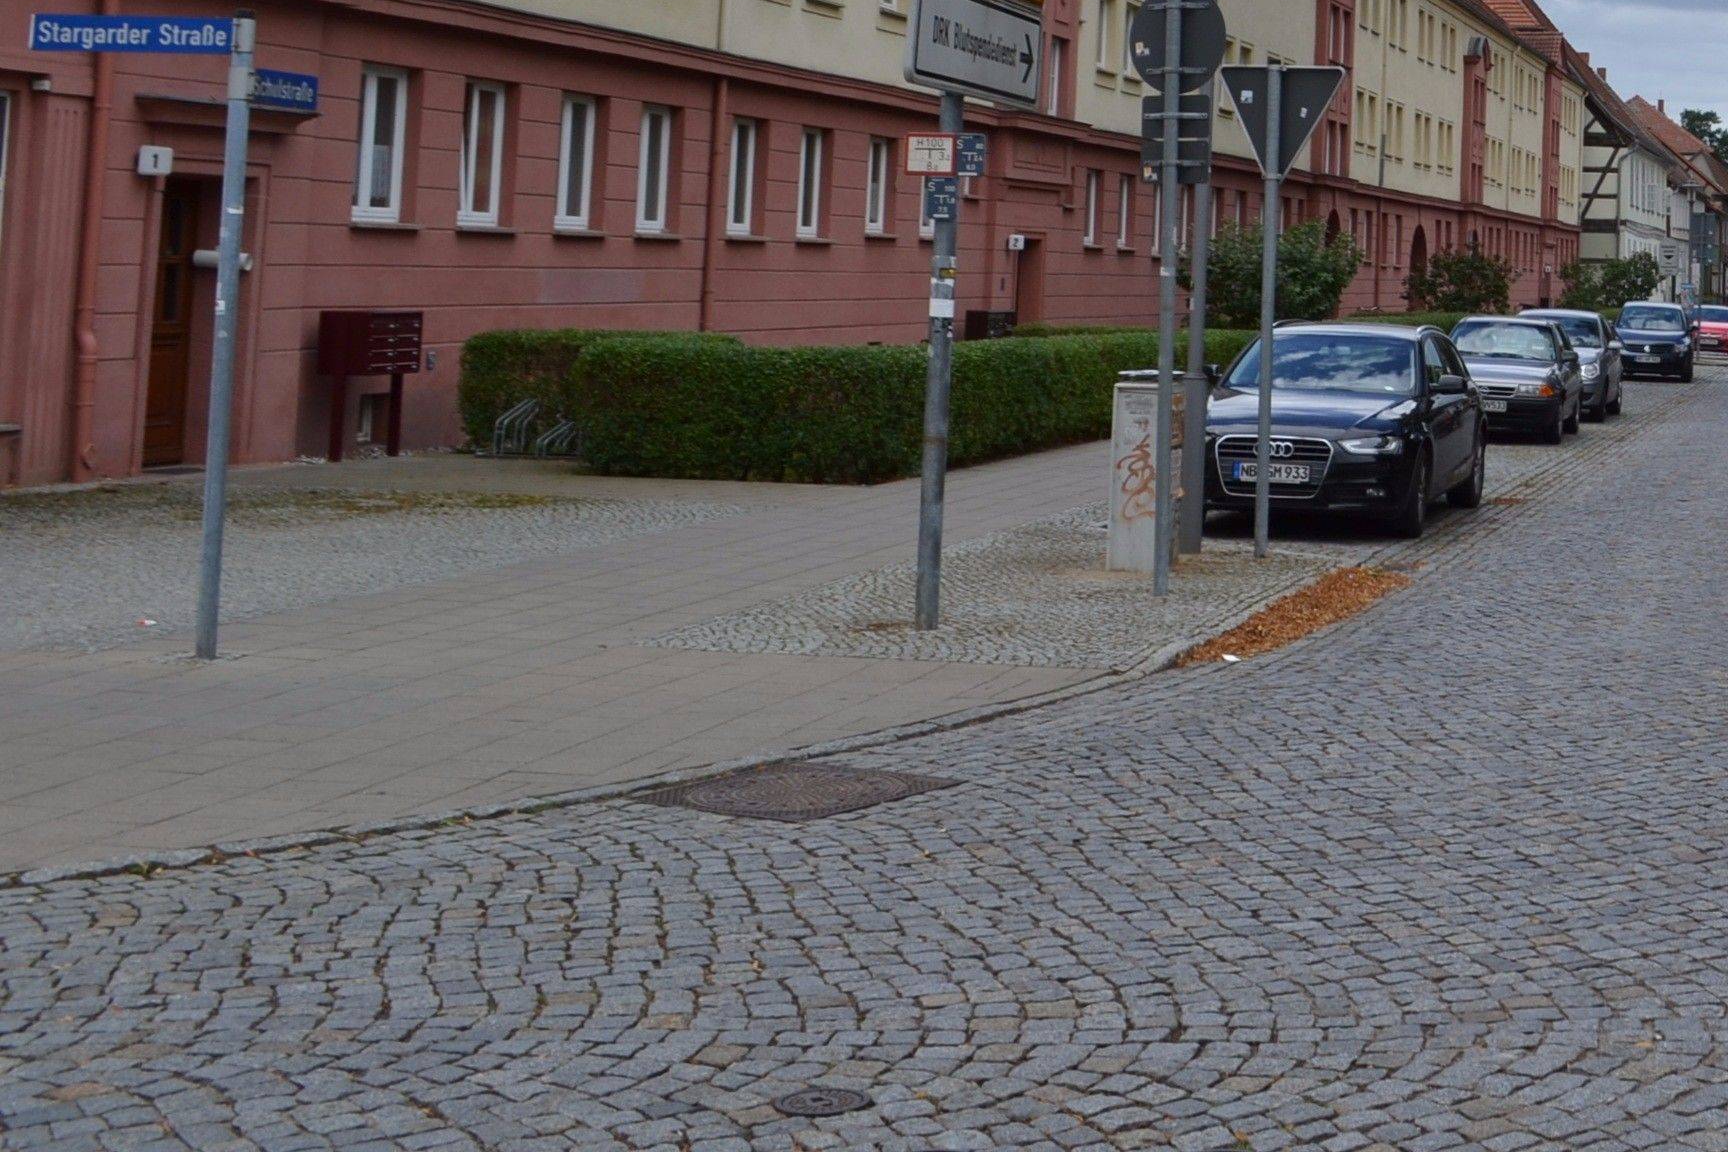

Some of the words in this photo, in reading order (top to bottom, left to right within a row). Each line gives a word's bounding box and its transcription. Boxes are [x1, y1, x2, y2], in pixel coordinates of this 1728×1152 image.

[38, 21, 151, 48] Stargarder
[158, 23, 227, 46] Straße
[933, 15, 950, 48] DRK
[1285, 466, 1308, 479] 933
